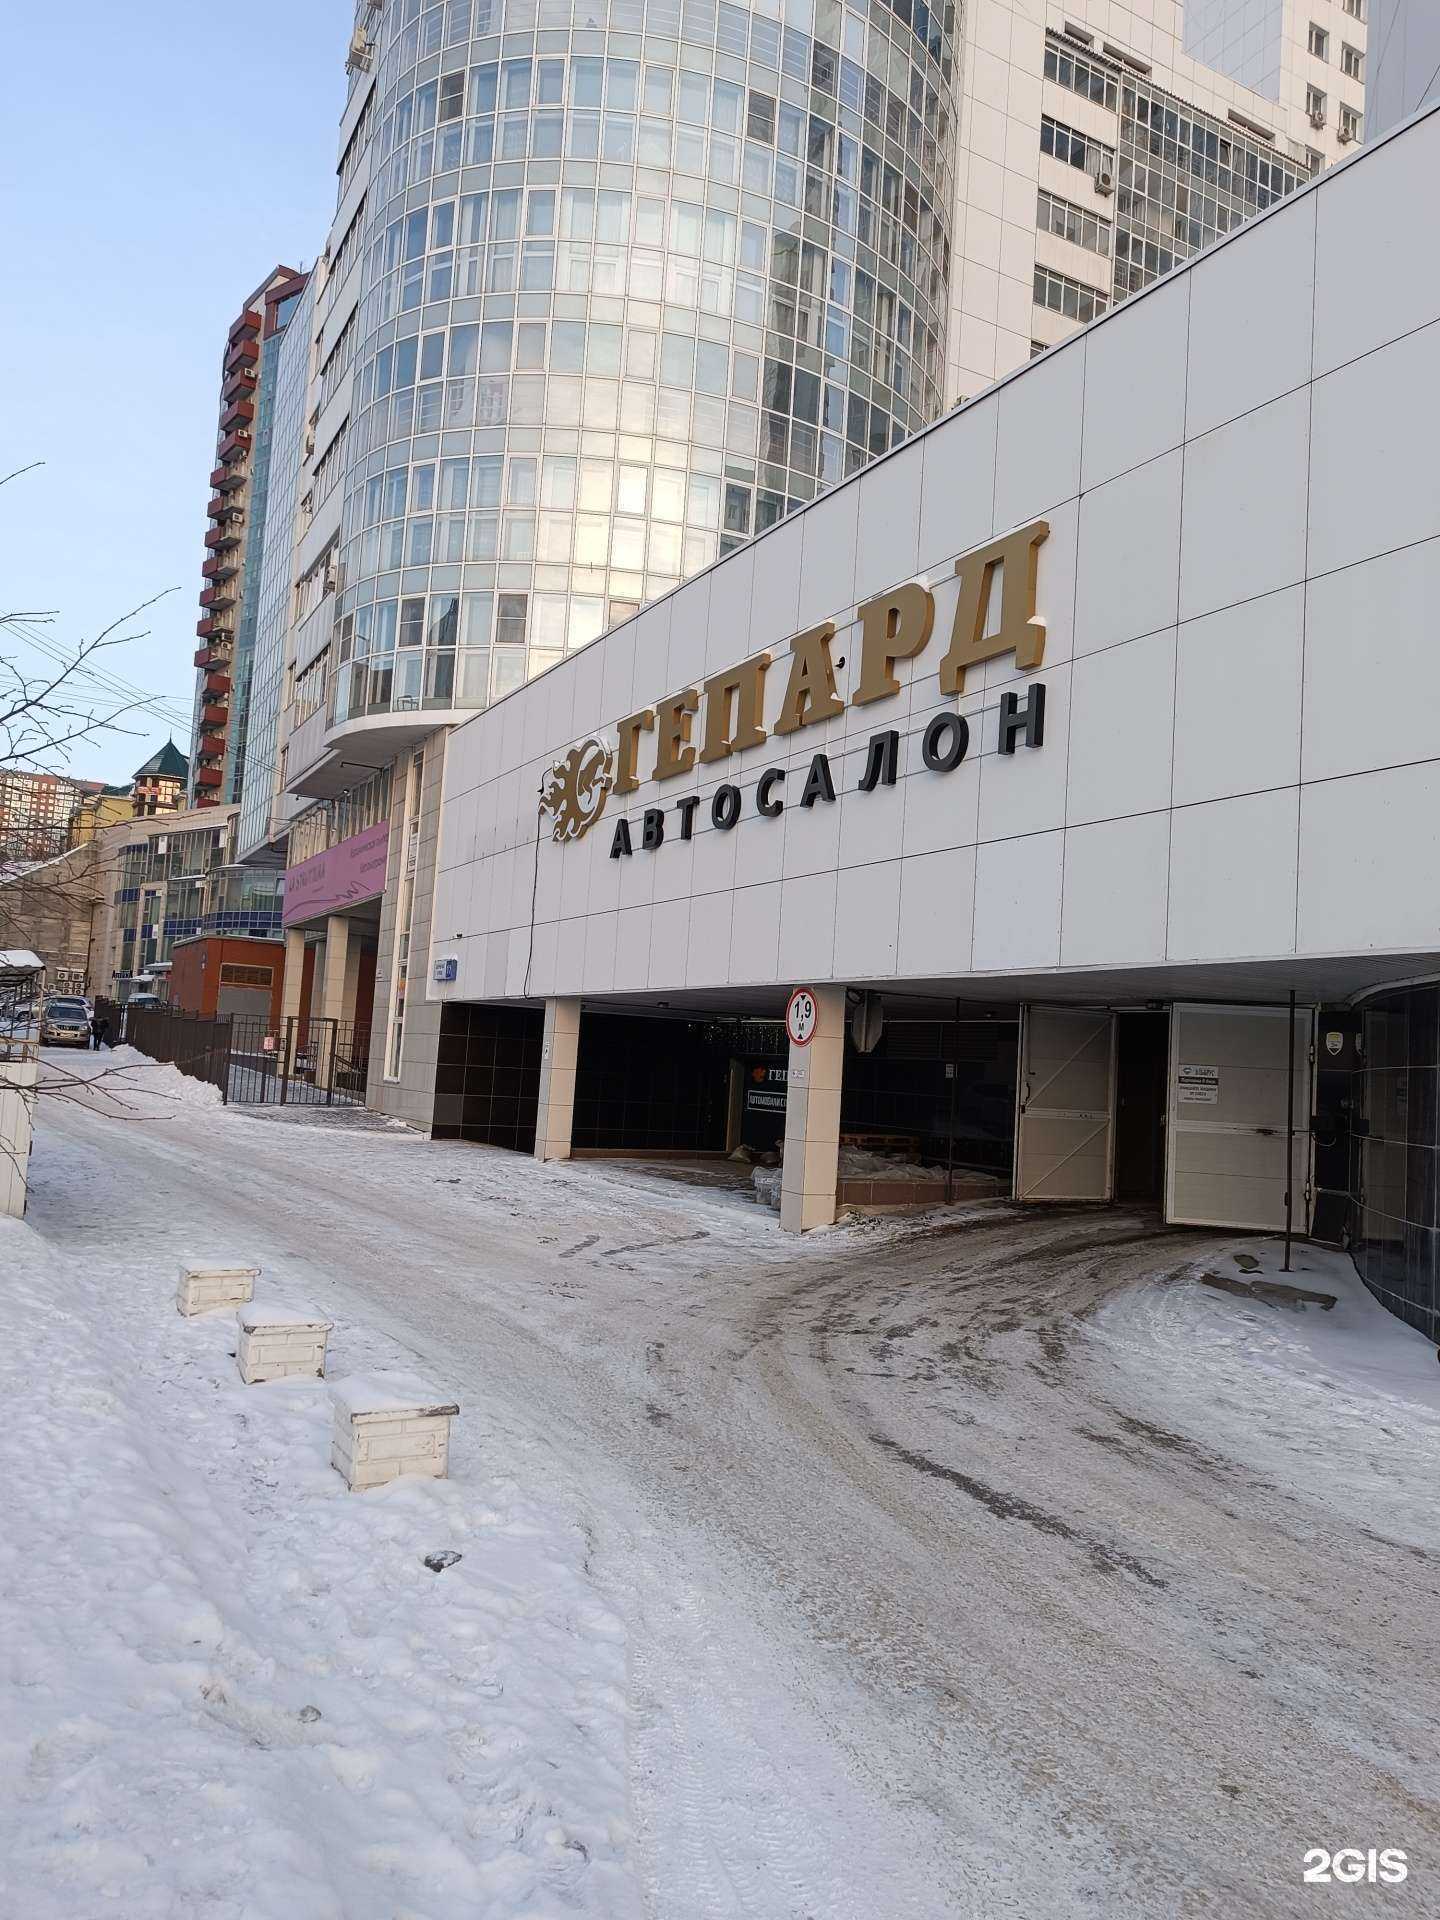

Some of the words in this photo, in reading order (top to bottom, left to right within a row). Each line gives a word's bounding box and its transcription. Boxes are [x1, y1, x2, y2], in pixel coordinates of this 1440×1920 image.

[612, 519, 1050, 795] ГЕПАРД
[609, 682, 1046, 859] АВТОСАЛОН
[794, 1000, 812, 1022] 1,9
